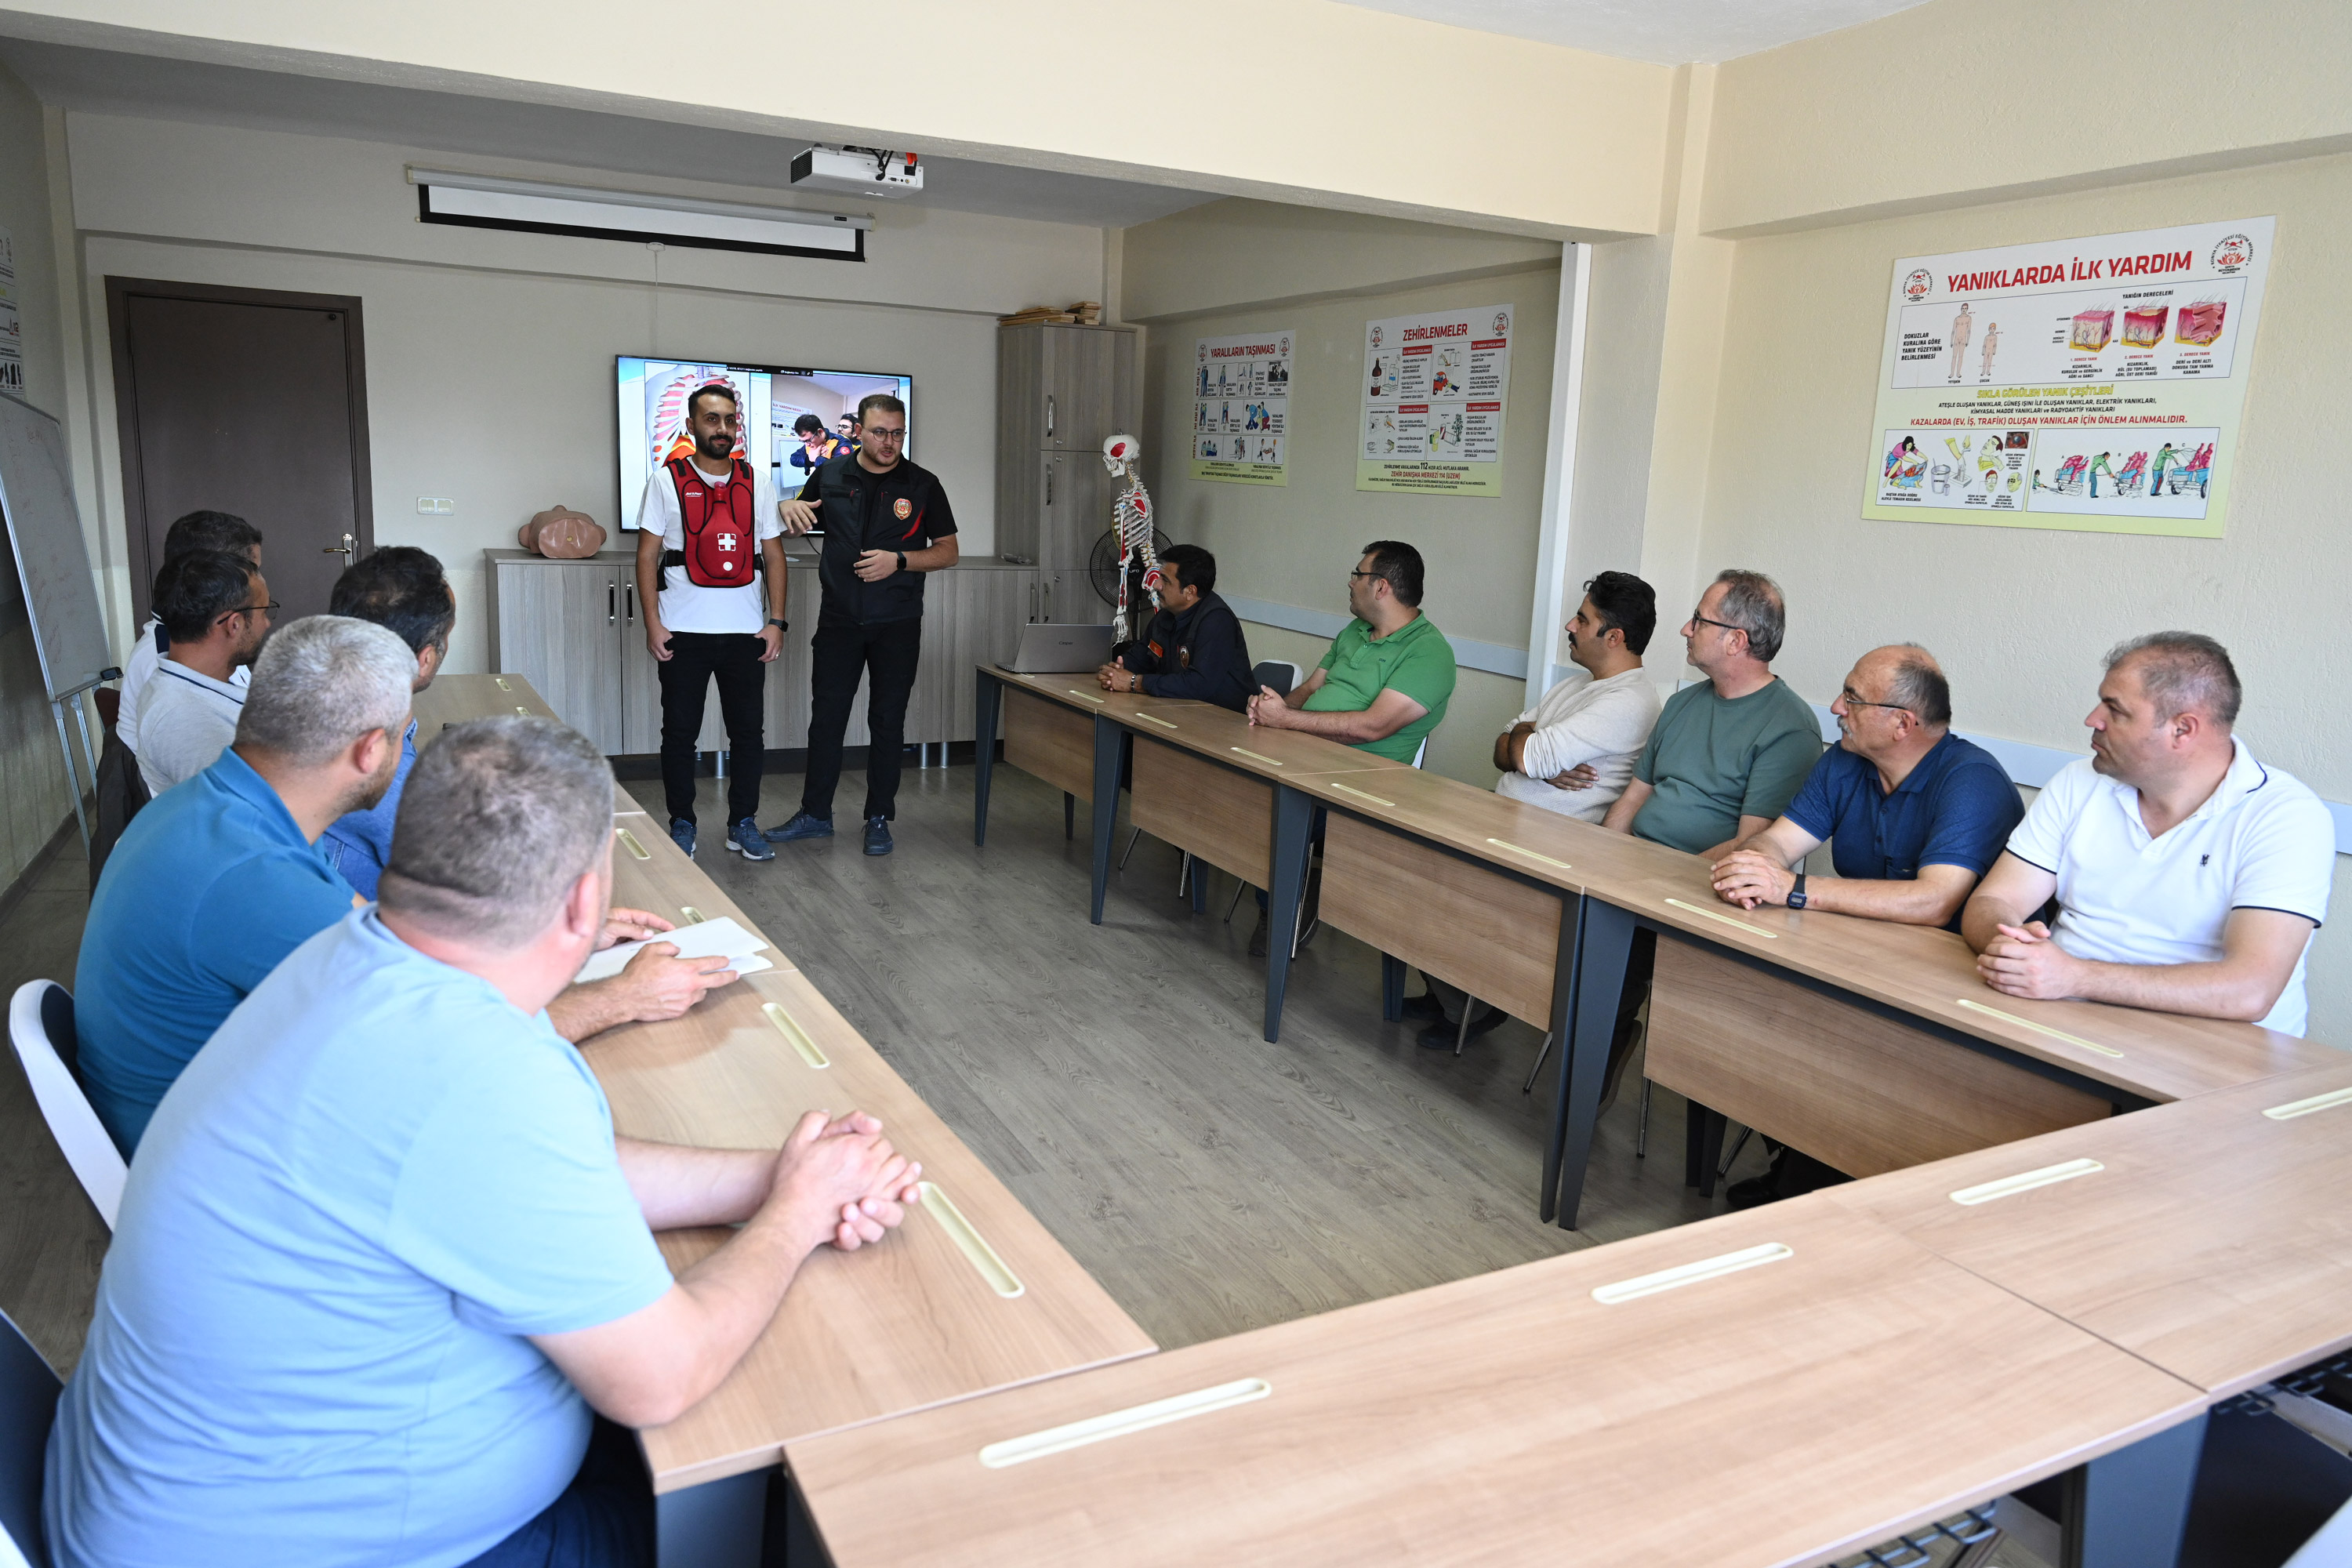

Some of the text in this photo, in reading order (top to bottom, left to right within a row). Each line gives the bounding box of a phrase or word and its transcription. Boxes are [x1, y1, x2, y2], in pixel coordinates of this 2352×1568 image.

[1948, 251, 2192, 292] YANIKLARDA İLK YARDIM
[2143, 289, 2174, 298] DERECELERİ
[1403, 323, 1468, 341] ZEHİRLENMELER
[1211, 343, 1276, 358] YARALILARIN TAŞINMASI
[1977, 384, 2114, 399] SIKLA GÖRÜLEN YANIK ÇEŞİTLERİ
[1954, 418, 1965, 426] (EV,
[1978, 416, 2006, 426] TRAFİK)
[2008, 417, 2038, 426] OLUŞAN
[2081, 415, 2096, 426] İÇİN
[2098, 415, 2127, 424] ÖNLEM
[2129, 416, 2187, 424] ALINMALIDIR.
